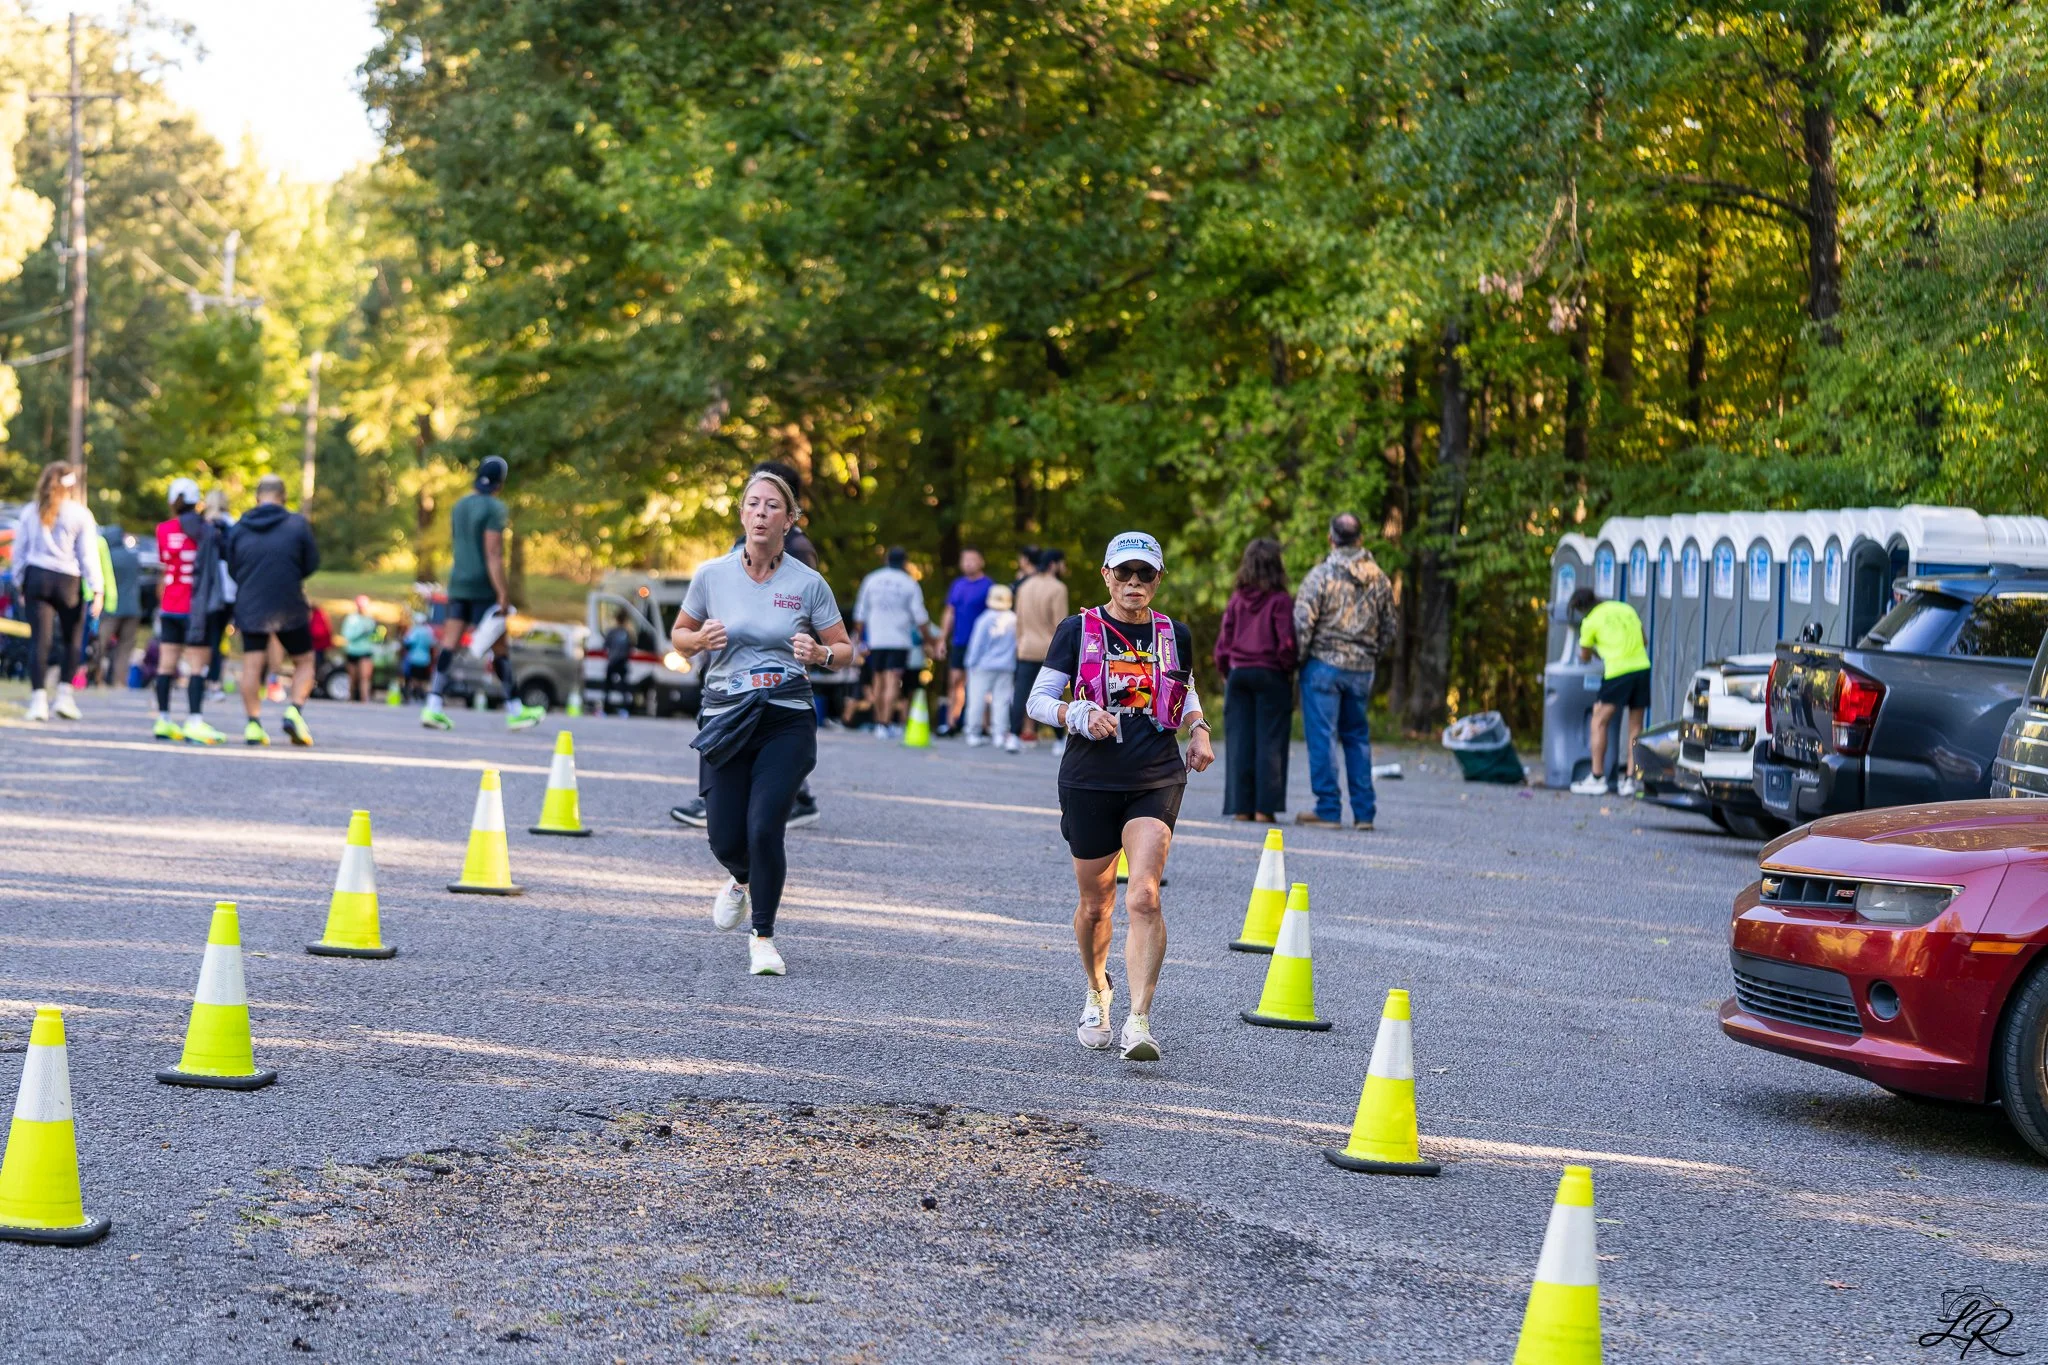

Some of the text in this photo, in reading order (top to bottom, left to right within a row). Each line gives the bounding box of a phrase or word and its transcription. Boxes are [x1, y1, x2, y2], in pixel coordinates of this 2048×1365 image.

[785, 594, 803, 602] Jude
[774, 599, 802, 611] HERO
[751, 673, 783, 688] 859
